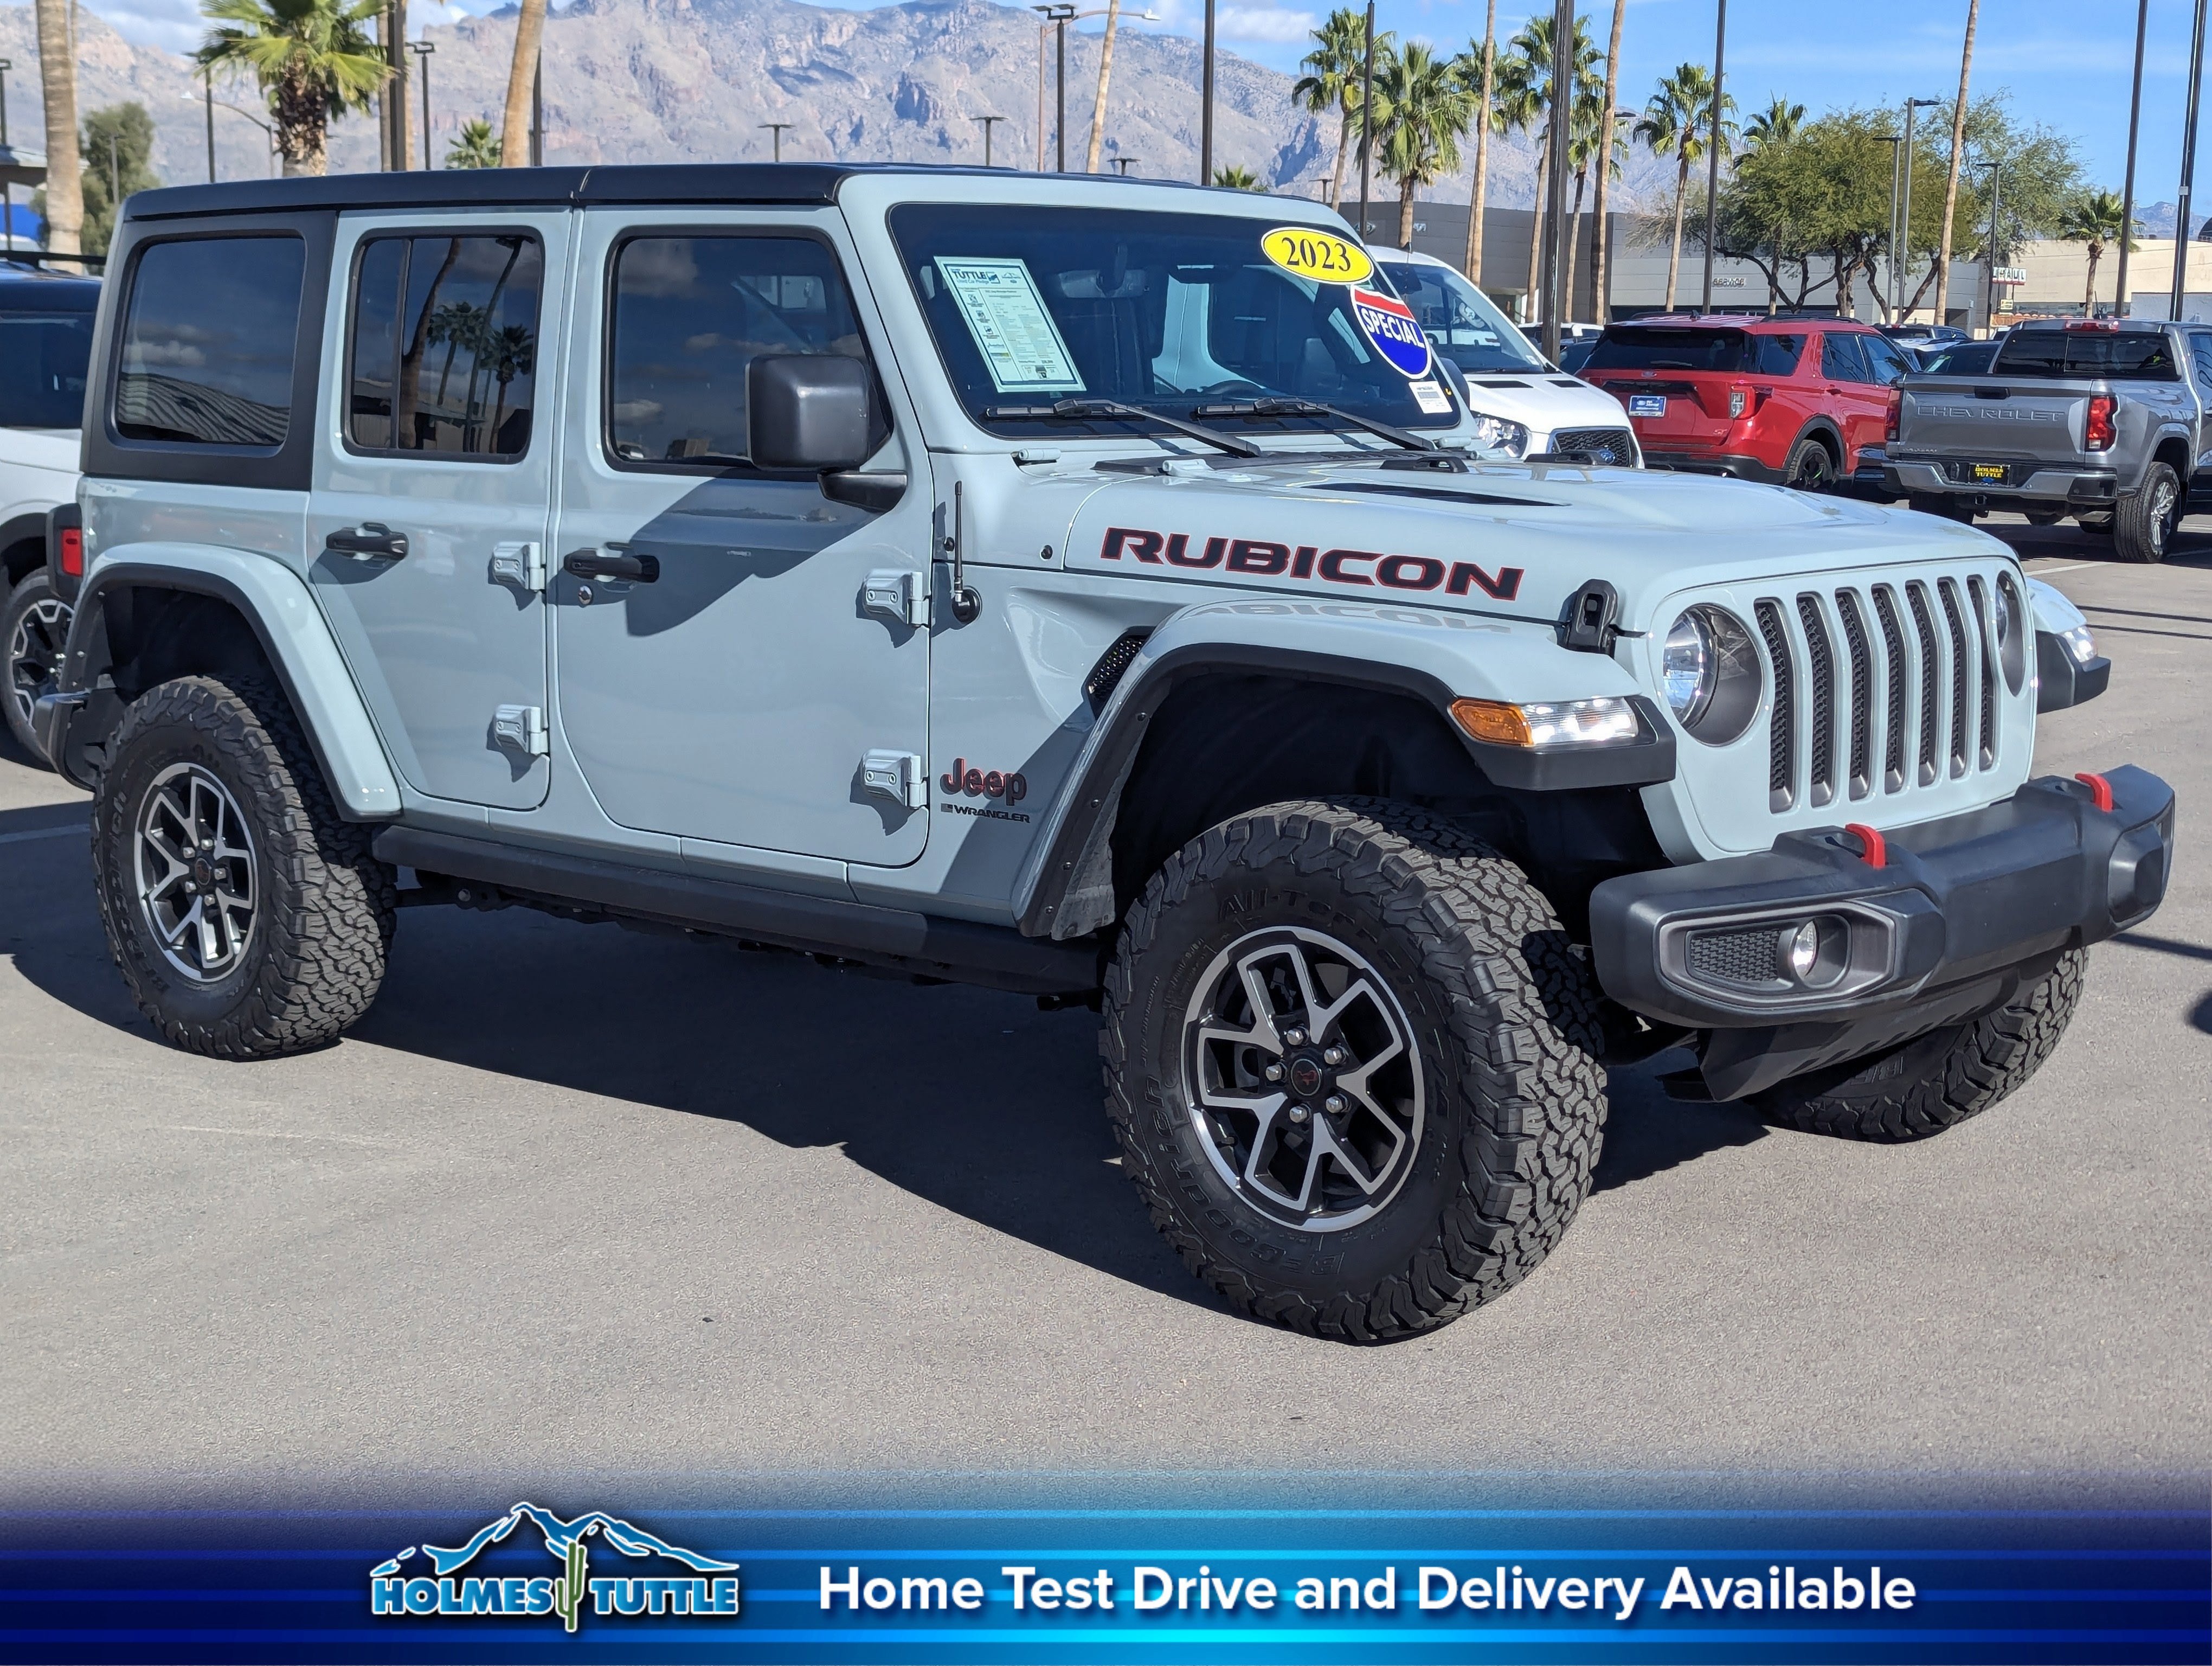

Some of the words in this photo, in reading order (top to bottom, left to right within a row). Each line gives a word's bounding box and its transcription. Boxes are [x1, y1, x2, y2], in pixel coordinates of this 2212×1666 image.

[1282, 237, 1351, 271] 2023
[1360, 307, 1426, 349] SPECIAL
[1917, 406, 2065, 422] CHEVROLET
[1101, 527, 1525, 601] RUBICON
[940, 758, 1027, 806] Jeep
[954, 804, 1030, 823] WRANGLER
